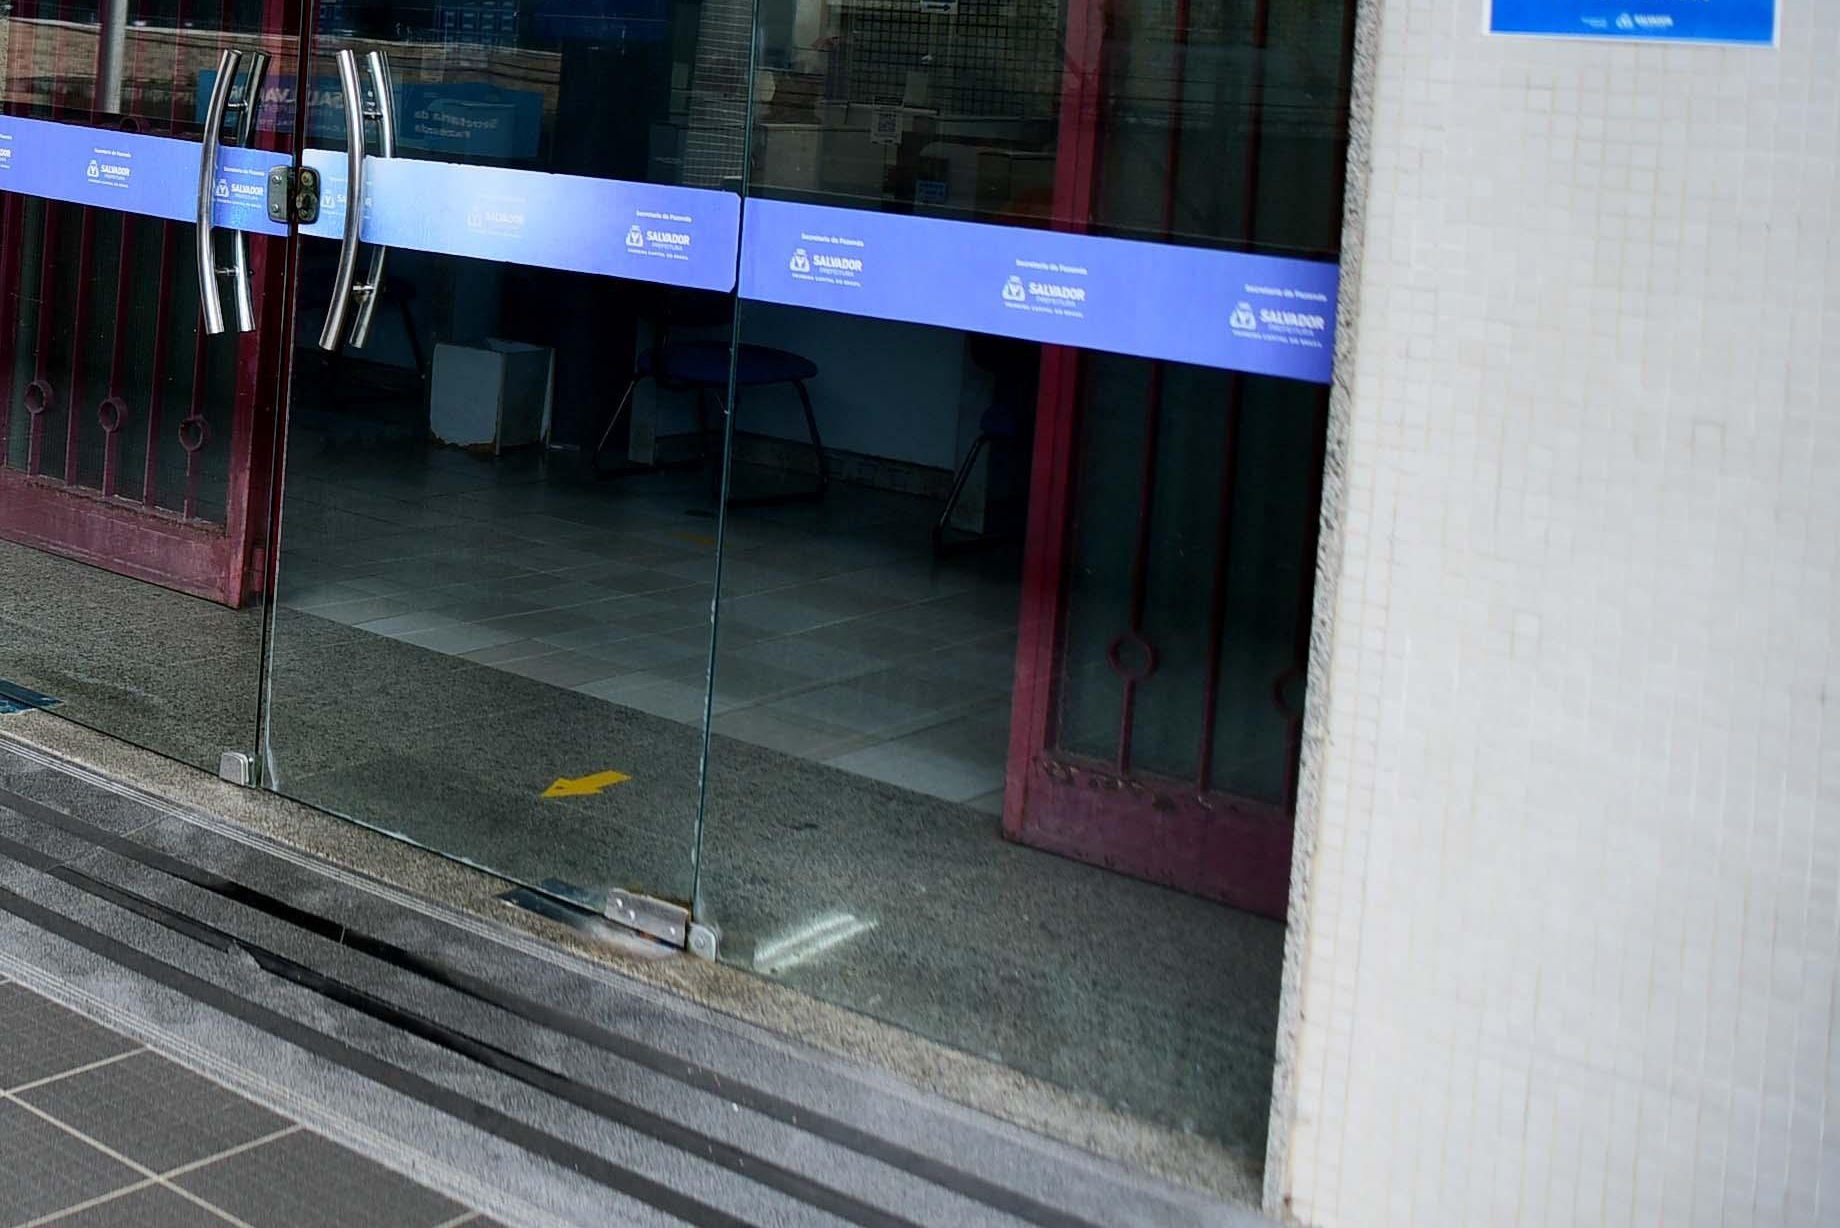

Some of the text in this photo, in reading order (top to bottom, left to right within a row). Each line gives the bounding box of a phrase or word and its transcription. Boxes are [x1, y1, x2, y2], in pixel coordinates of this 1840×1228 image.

[100, 164, 130, 177] SALVADOR
[231, 183, 264, 196] SALVADOR
[647, 231, 690, 245] SALVADOR
[813, 255, 863, 271] SALVADOR
[1028, 282, 1085, 301] SALVADOR
[1260, 308, 1325, 330] SALVADOR
